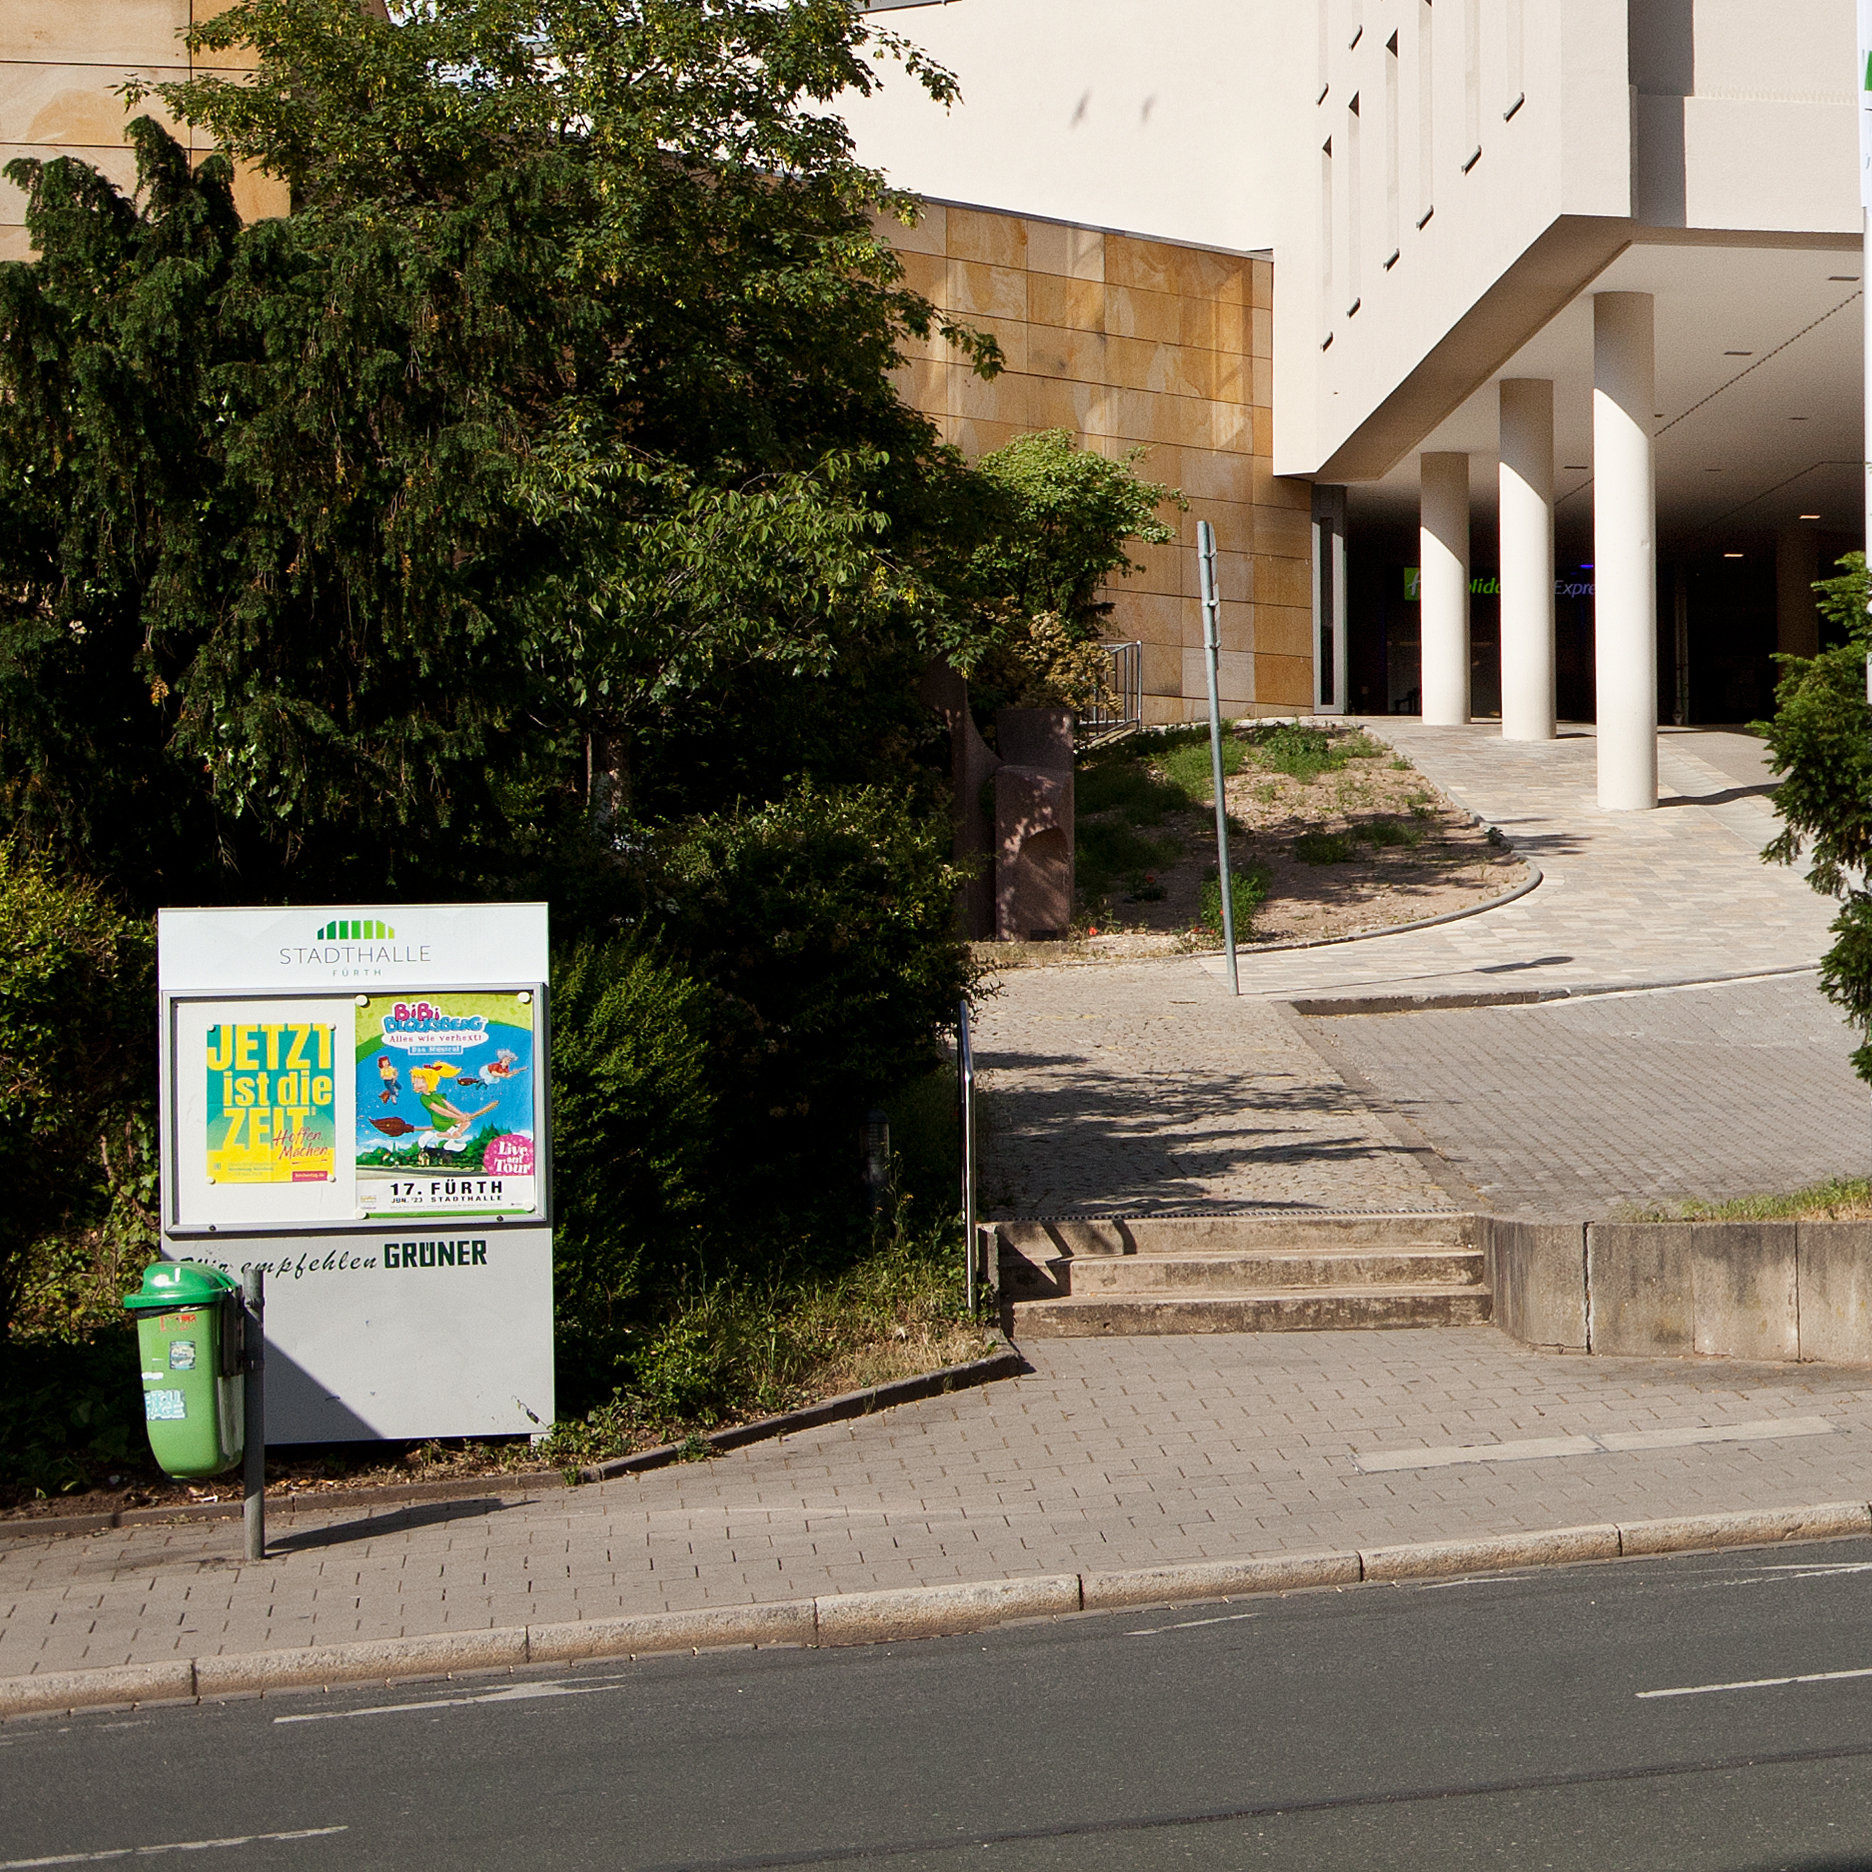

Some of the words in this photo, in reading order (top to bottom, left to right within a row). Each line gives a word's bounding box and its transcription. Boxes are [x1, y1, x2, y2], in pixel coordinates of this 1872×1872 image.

[279, 945, 432, 966] STADTHALLE
[332, 968, 382, 977] FÜRTH
[389, 1035, 413, 1043] Alles
[207, 1024, 332, 1071] JETZT
[223, 1070, 270, 1107] ist
[277, 1069, 333, 1106] die
[498, 1141, 528, 1155] Live
[494, 1158, 531, 1174] Tour
[390, 1182, 422, 1196] 17.
[431, 1179, 503, 1195] FÜRTH
[431, 1195, 502, 1203] STADTHALLE
[240, 1249, 377, 1279] empfehlen
[384, 1240, 487, 1269] GRÜNER
